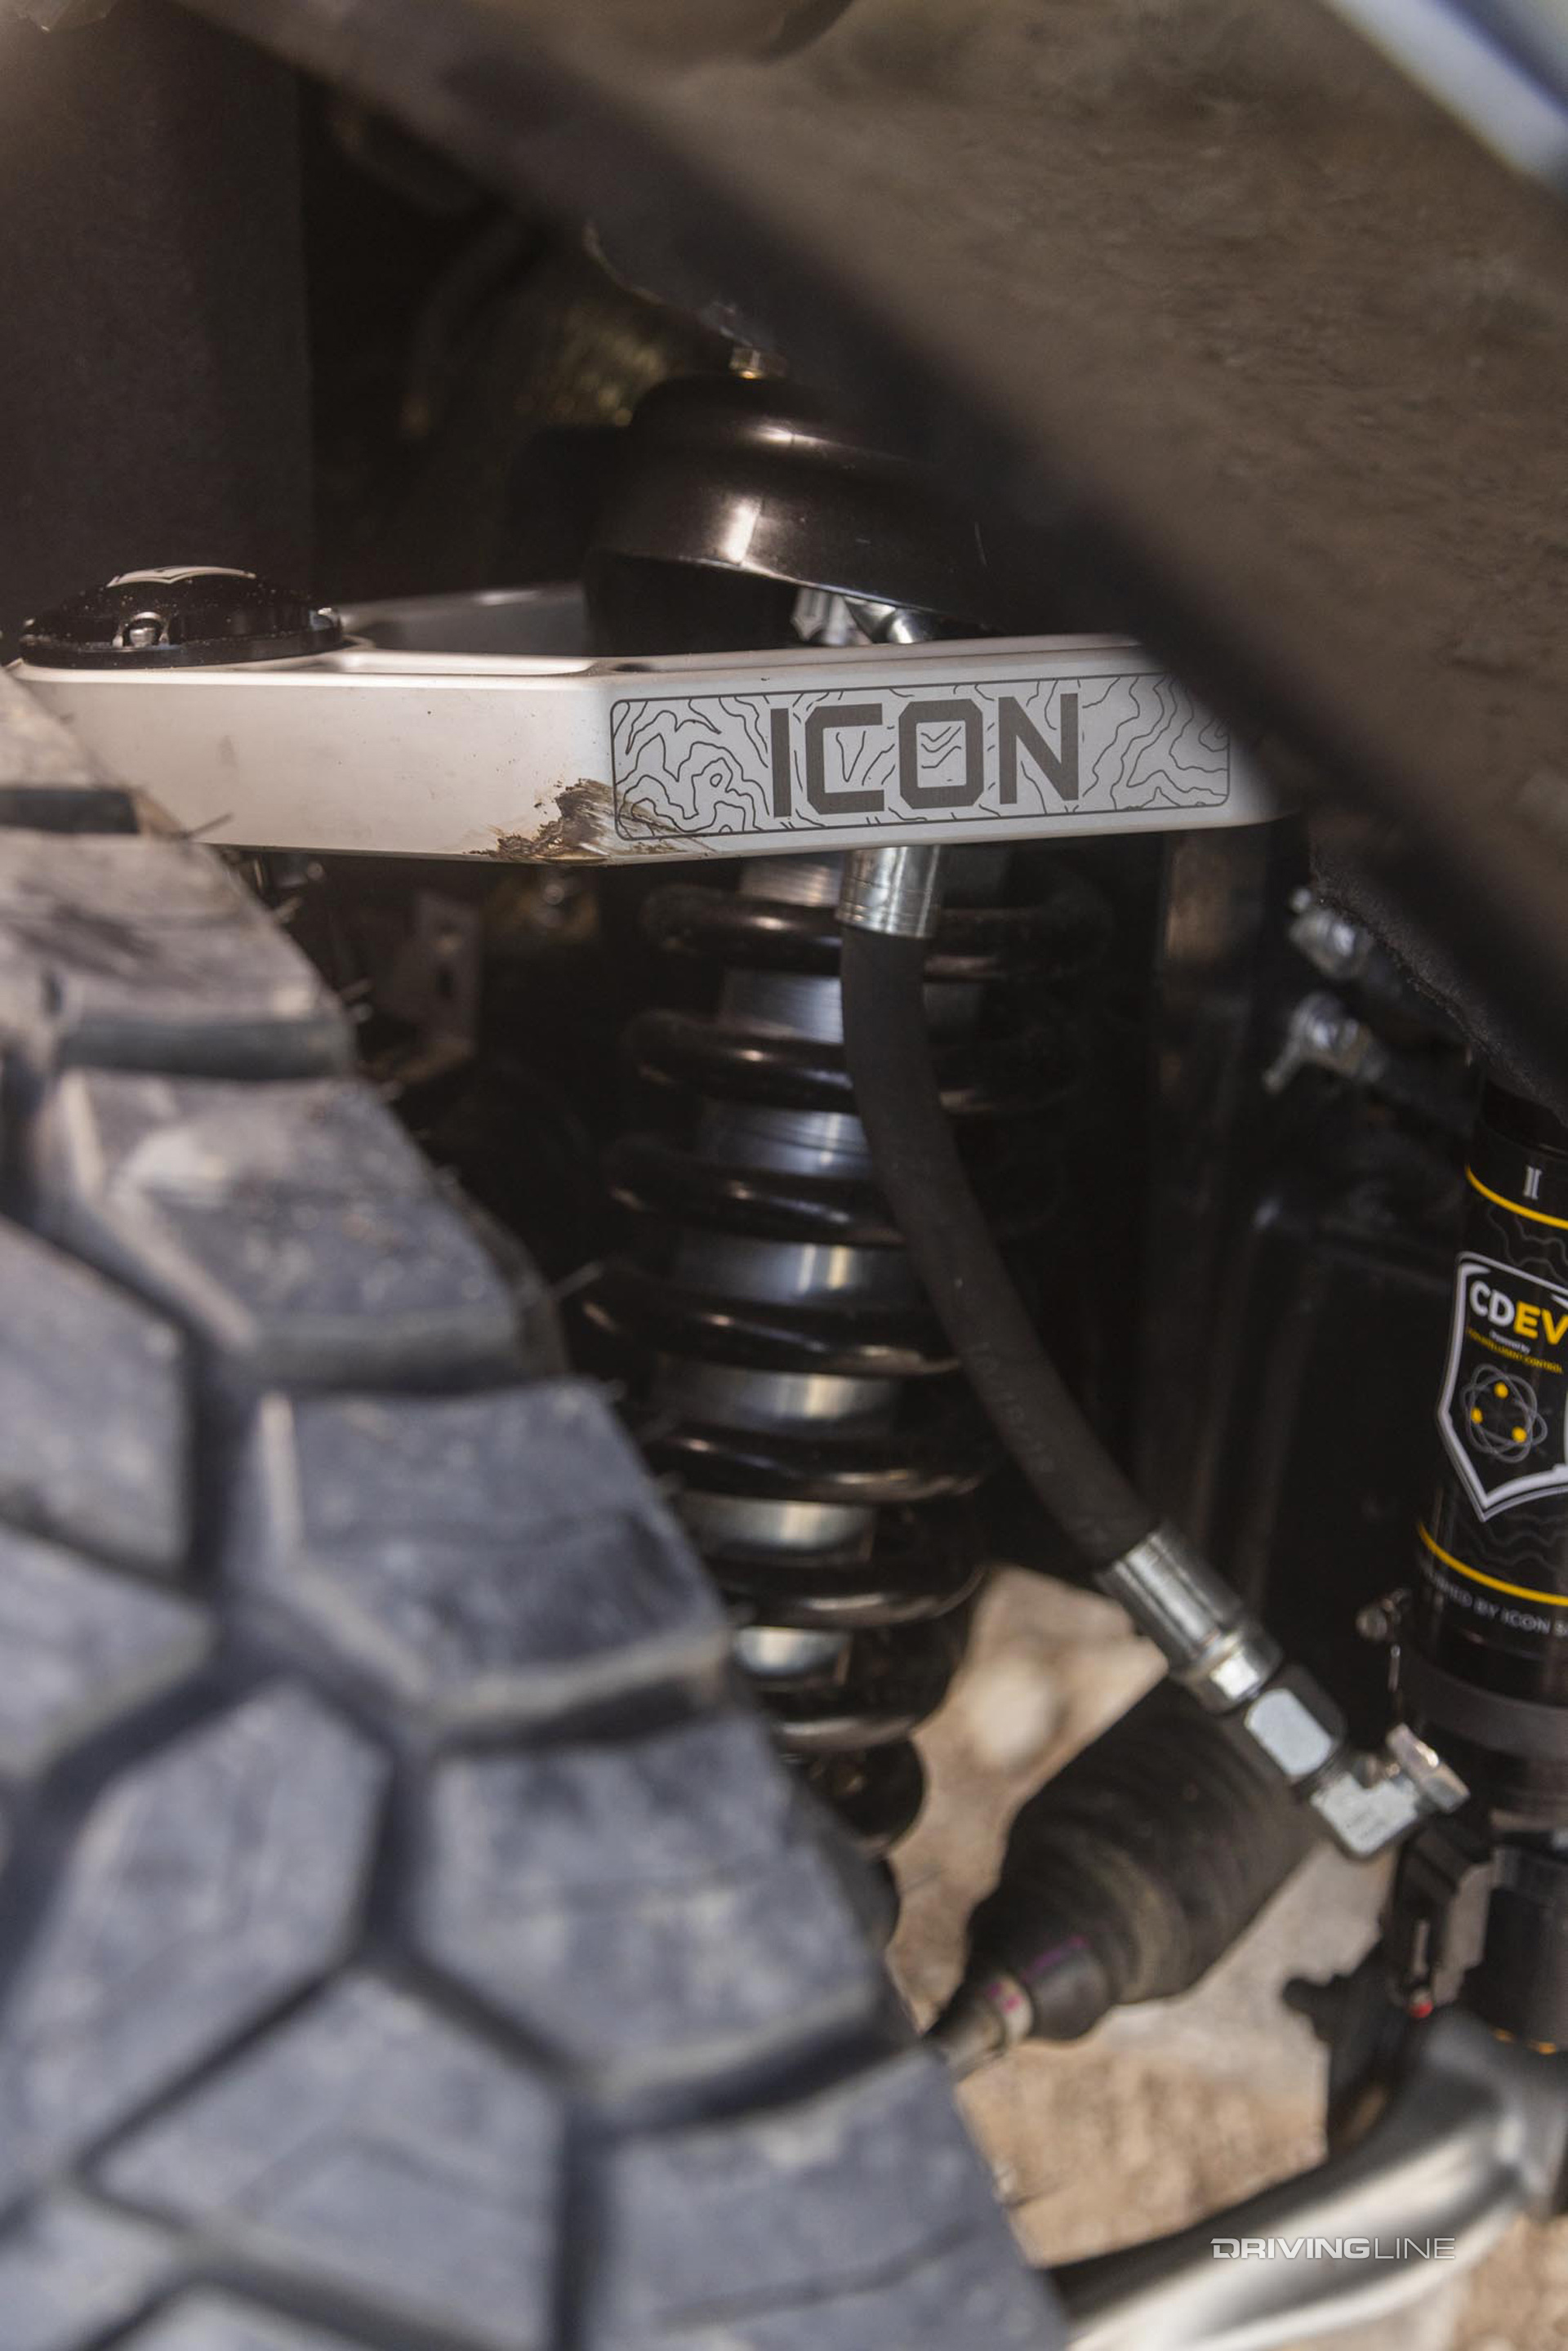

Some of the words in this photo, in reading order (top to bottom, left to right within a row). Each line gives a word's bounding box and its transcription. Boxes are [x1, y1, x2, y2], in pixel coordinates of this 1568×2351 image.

[770, 692, 1080, 817] ICON
[1469, 1280, 1568, 1346] CDEV
[1501, 1607, 1551, 1634] ICON
